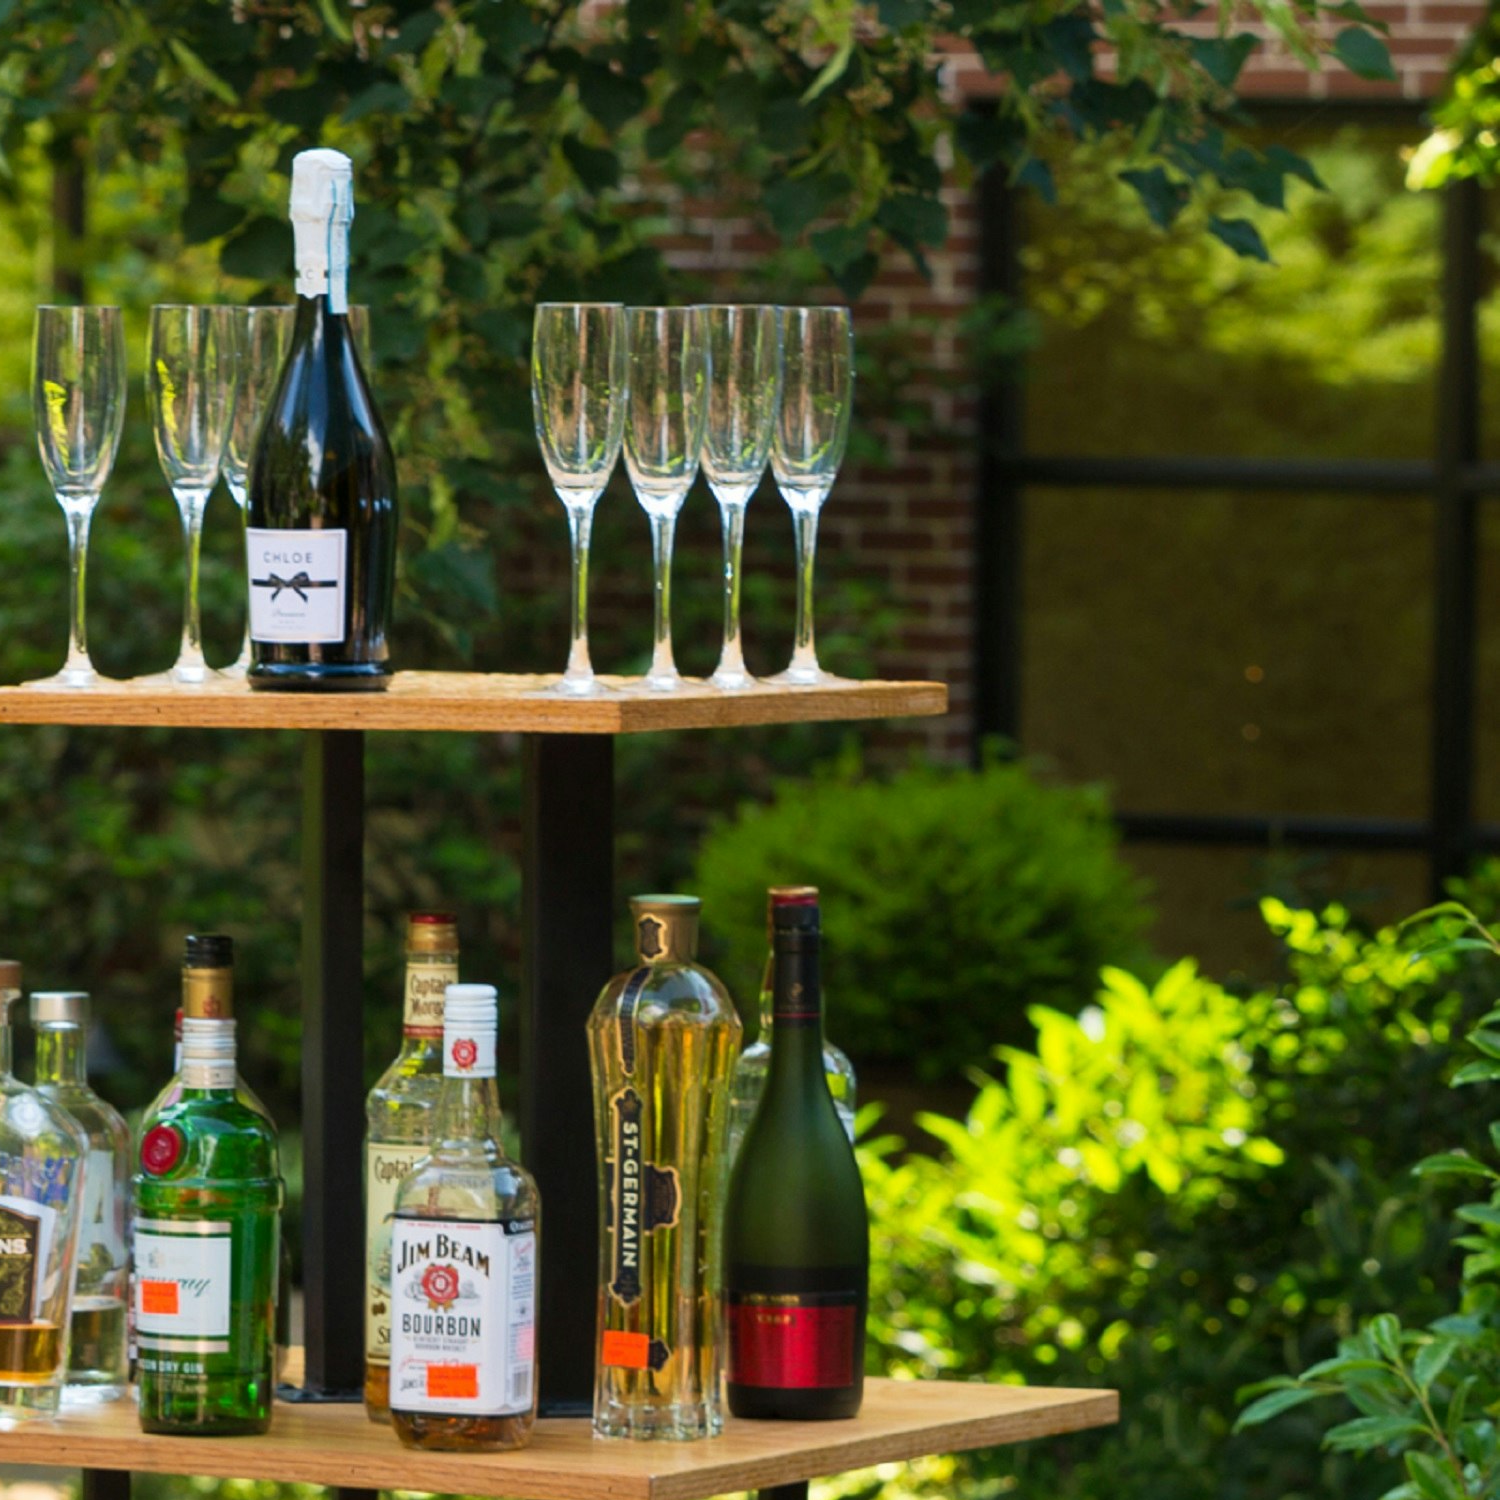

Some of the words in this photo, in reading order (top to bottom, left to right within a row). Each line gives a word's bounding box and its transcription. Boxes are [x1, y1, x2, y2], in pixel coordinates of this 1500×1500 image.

[409, 998, 445, 1020] Morg
[622, 1121, 638, 1267] ST-GERMAIN
[397, 1240, 430, 1274] JIM
[436, 1233, 490, 1277] BEAM
[402, 1313, 481, 1337] BOURBON
